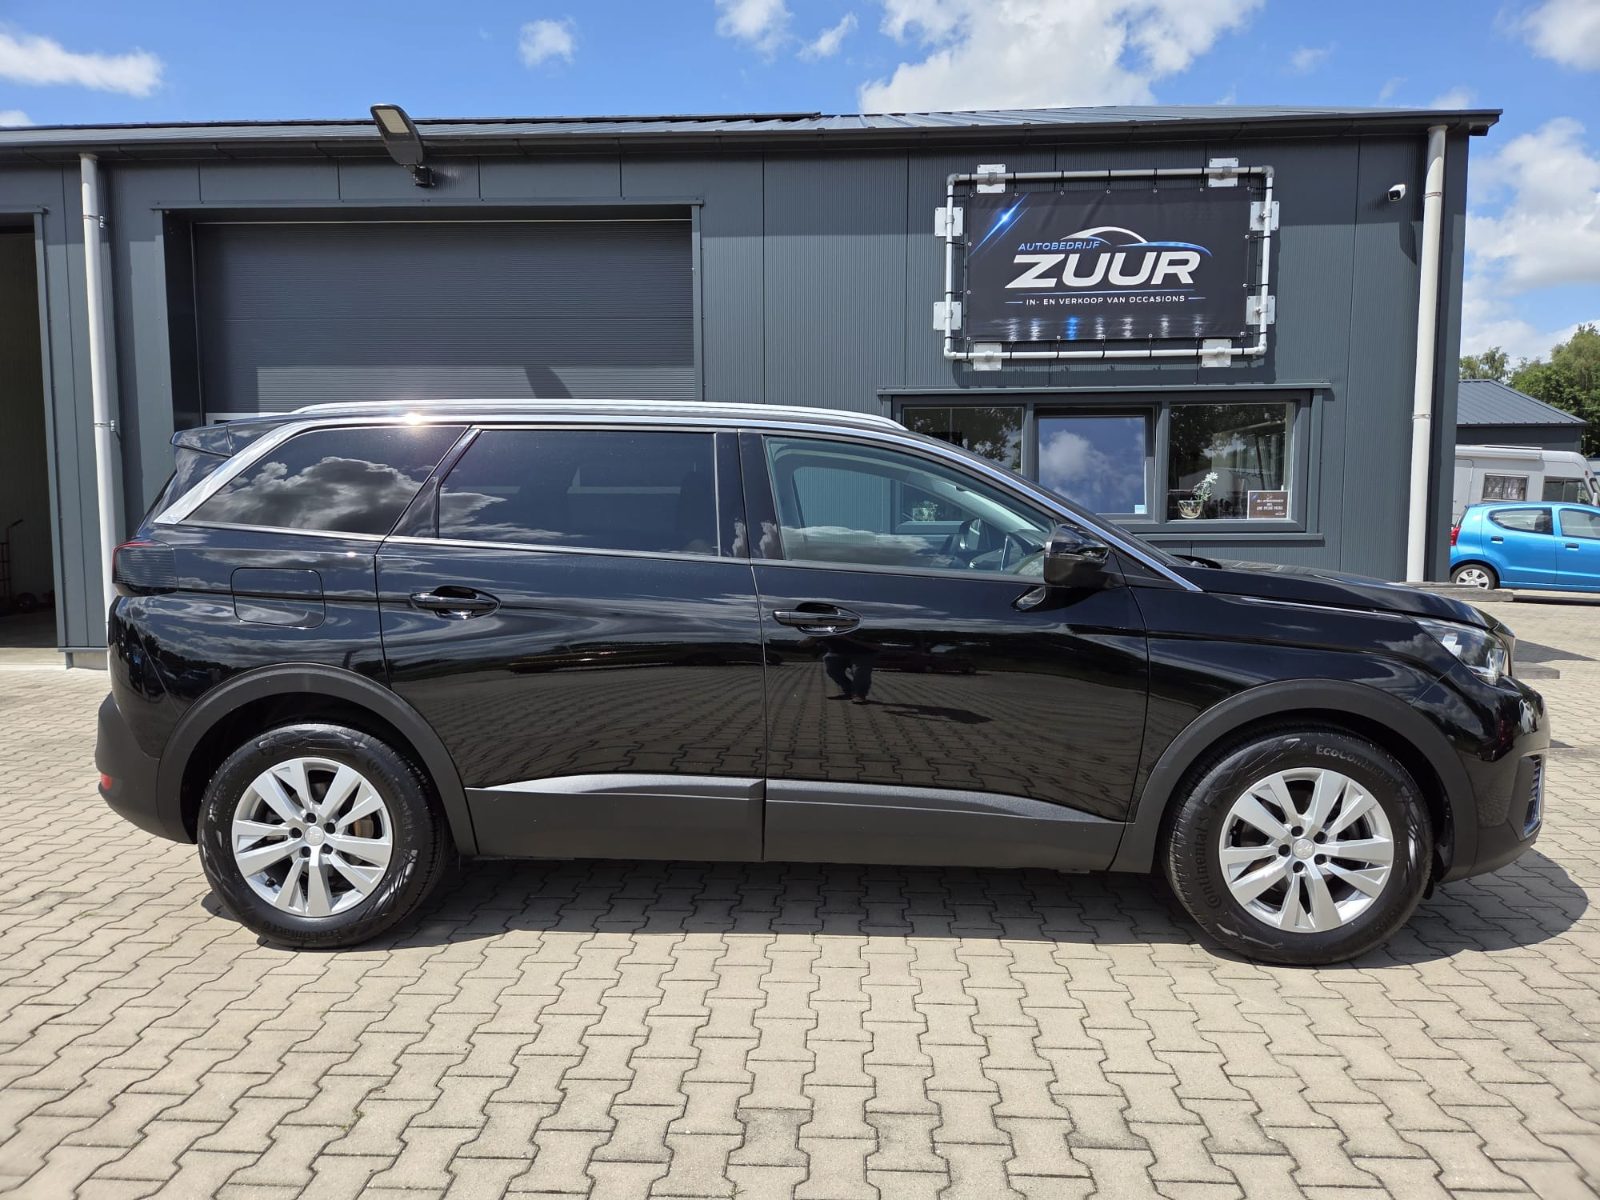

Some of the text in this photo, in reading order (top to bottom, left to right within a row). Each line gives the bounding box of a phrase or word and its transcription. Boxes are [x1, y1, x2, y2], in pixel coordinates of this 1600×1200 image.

[1018, 241, 1100, 251] AUTOBEDRIJF
[1004, 251, 1200, 289] ZUUR
[1059, 297, 1103, 305] VERKOOP
[1129, 295, 1185, 303] OCCASIONS
